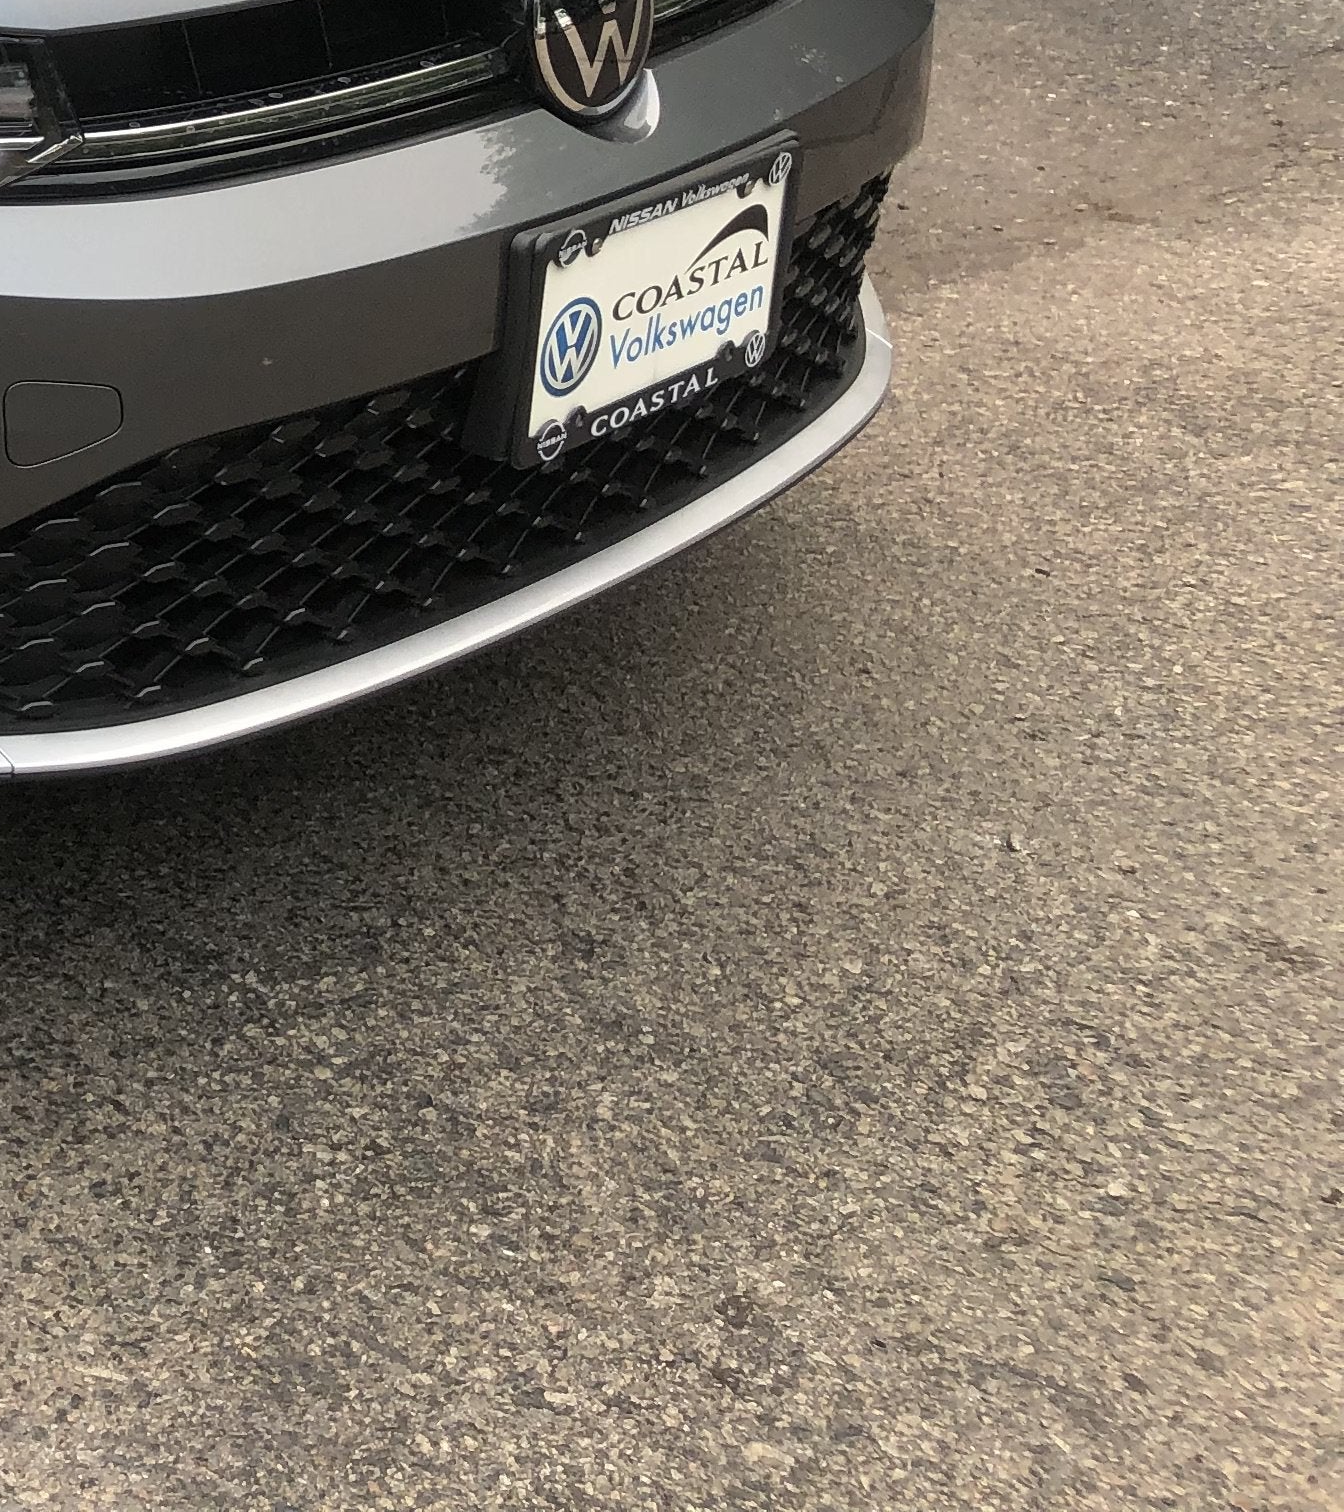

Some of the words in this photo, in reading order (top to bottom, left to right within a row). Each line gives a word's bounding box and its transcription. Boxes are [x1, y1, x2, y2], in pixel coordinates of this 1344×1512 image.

[608, 197, 679, 235] NISSAN
[681, 172, 750, 207] Volkswagen
[611, 240, 769, 322] COASTAL
[609, 285, 764, 370] Volkswagen
[590, 366, 719, 437] COASTAL
